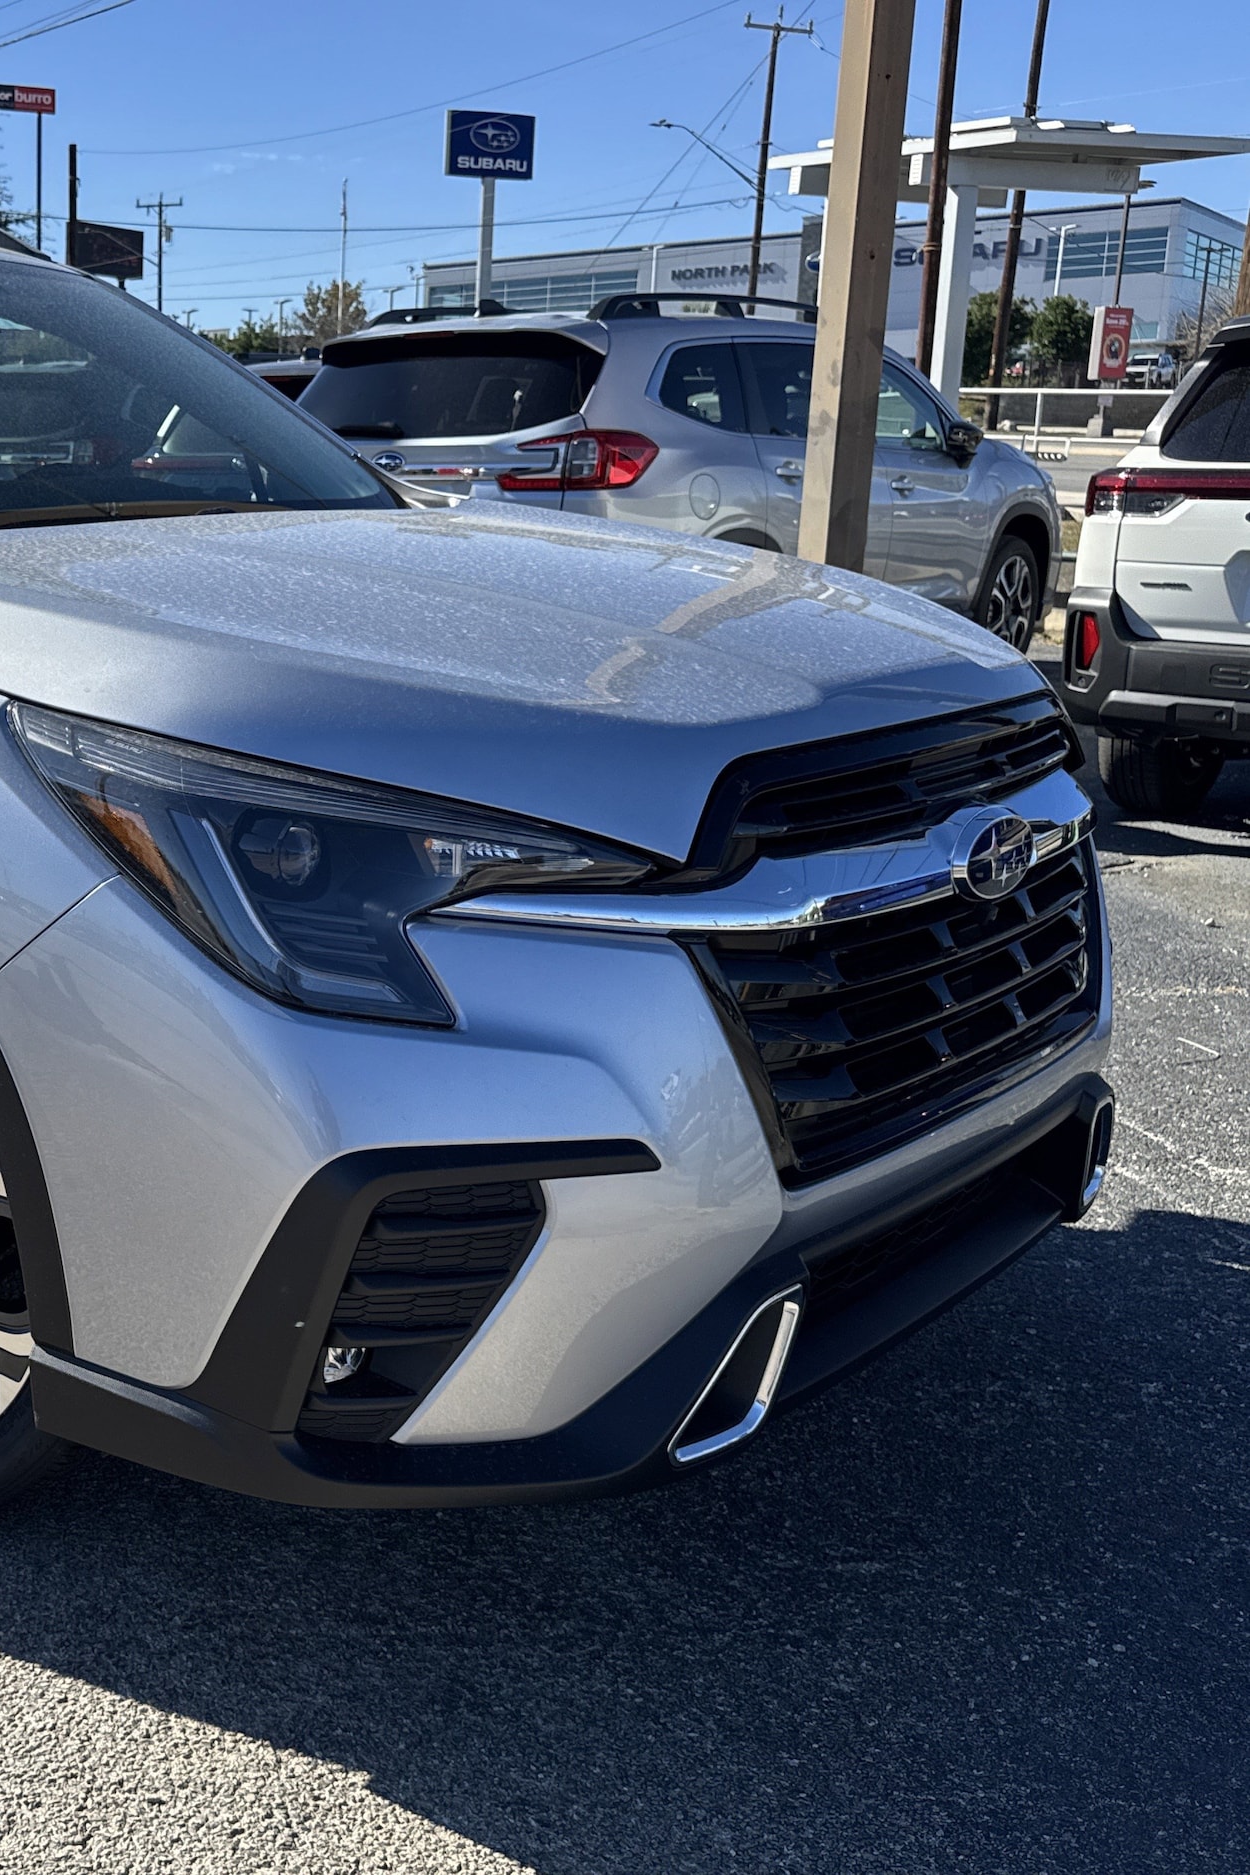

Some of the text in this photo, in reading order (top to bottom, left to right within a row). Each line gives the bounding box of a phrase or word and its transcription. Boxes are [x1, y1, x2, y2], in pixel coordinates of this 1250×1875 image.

[14, 90, 52, 105] burro
[457, 155, 528, 172] SUBARU
[671, 265, 727, 281] NORTH
